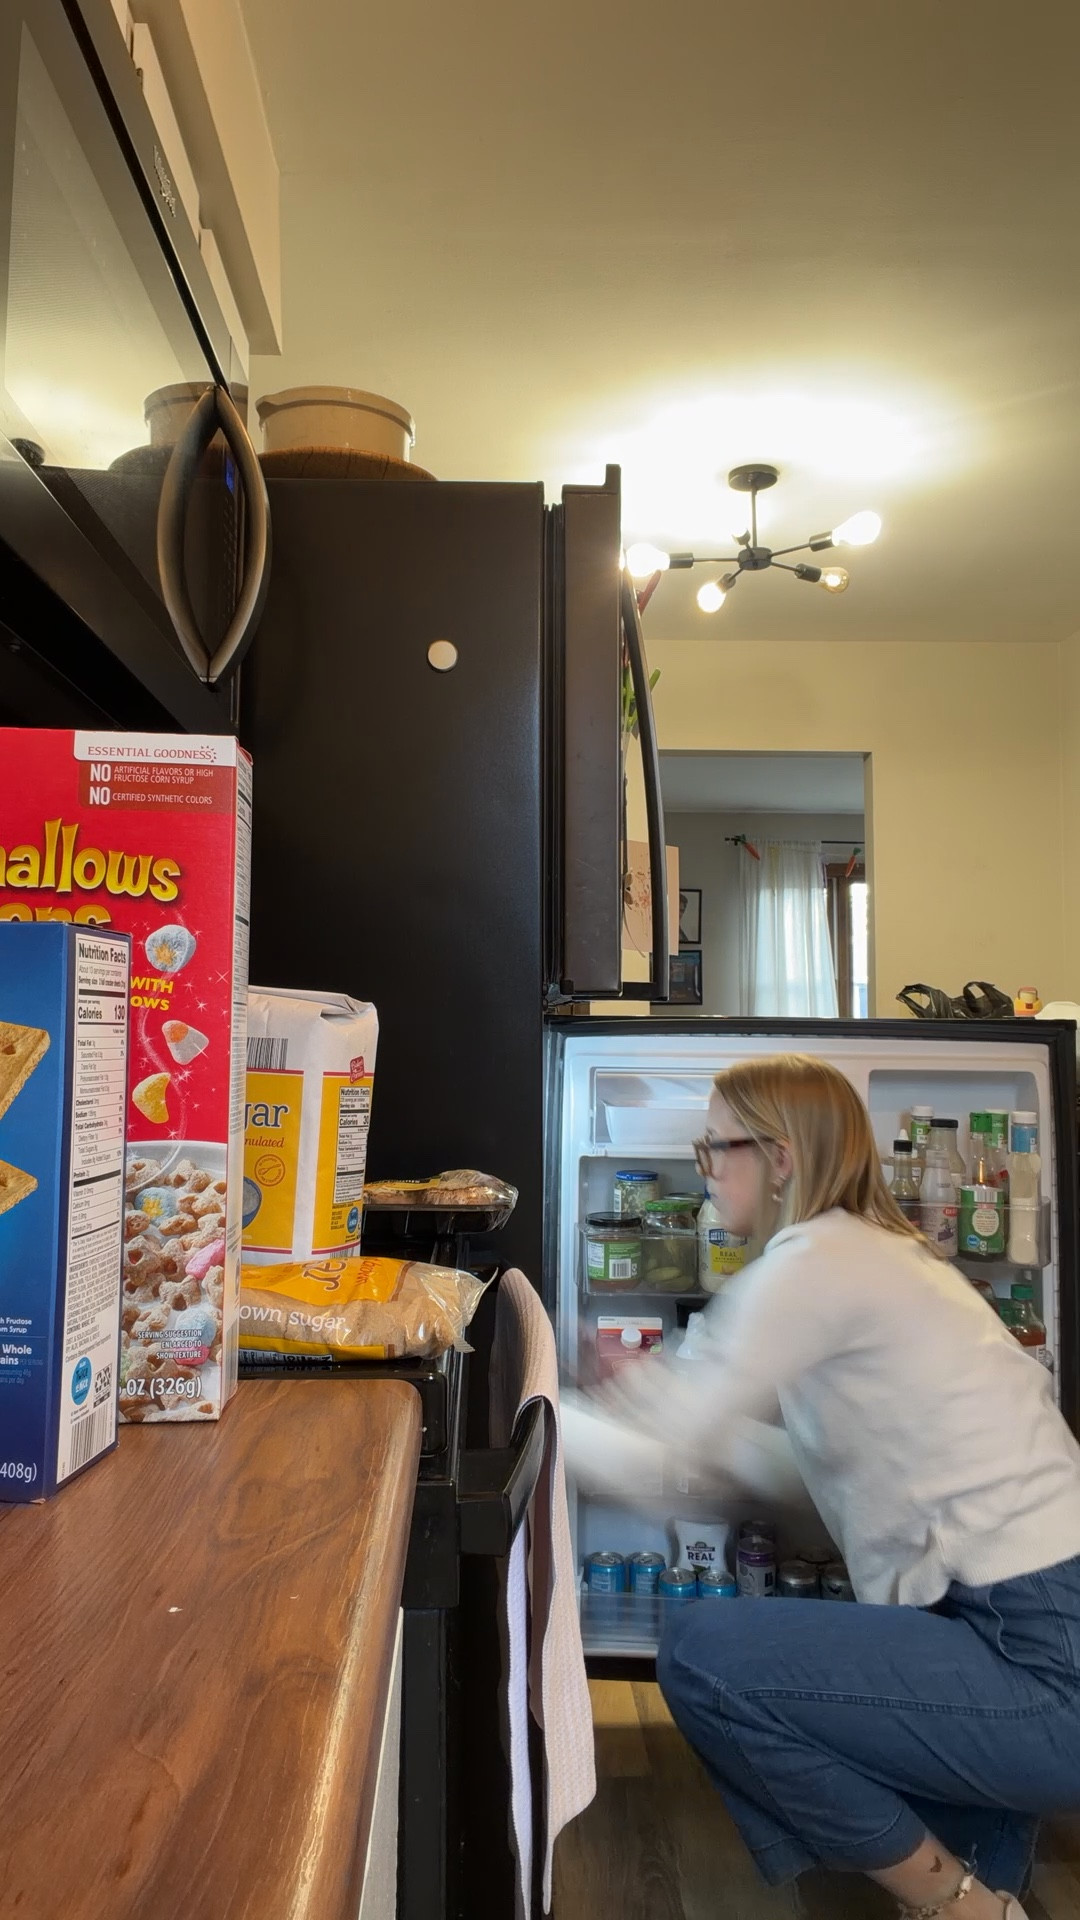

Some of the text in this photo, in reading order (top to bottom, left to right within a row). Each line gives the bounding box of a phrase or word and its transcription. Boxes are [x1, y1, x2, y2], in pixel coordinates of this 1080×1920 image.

[88, 746, 212, 760] ESSENTIAL GOODNESS
[90, 764, 112, 782] NO
[114, 766, 214, 778] ARTIFICIAL FLAVORS OR HIGH
[114, 774, 194, 785] FRUCTOSE CORN SYRUP
[89, 786, 111, 806] NO
[112, 792, 212, 805] CERTIFIED SYNTHETIC COLORS
[78, 942, 126, 964] Nutrition Facts
[78, 1005, 125, 1020] Calories 130
[6, 1316, 32, 1326] Fructose
[288, 1310, 346, 1333] sugar
[9, 1326, 28, 1334] Syrup
[138, 1329, 202, 1339] SERVING SUGGESTION
[2, 1344, 32, 1355] Whole
[162, 1340, 202, 1349] ENLARGED TO
[156, 1350, 202, 1360] SHOW TEXTURE
[126, 1376, 202, 1400] OZ (326g)
[688, 1552, 714, 1561] REAL
